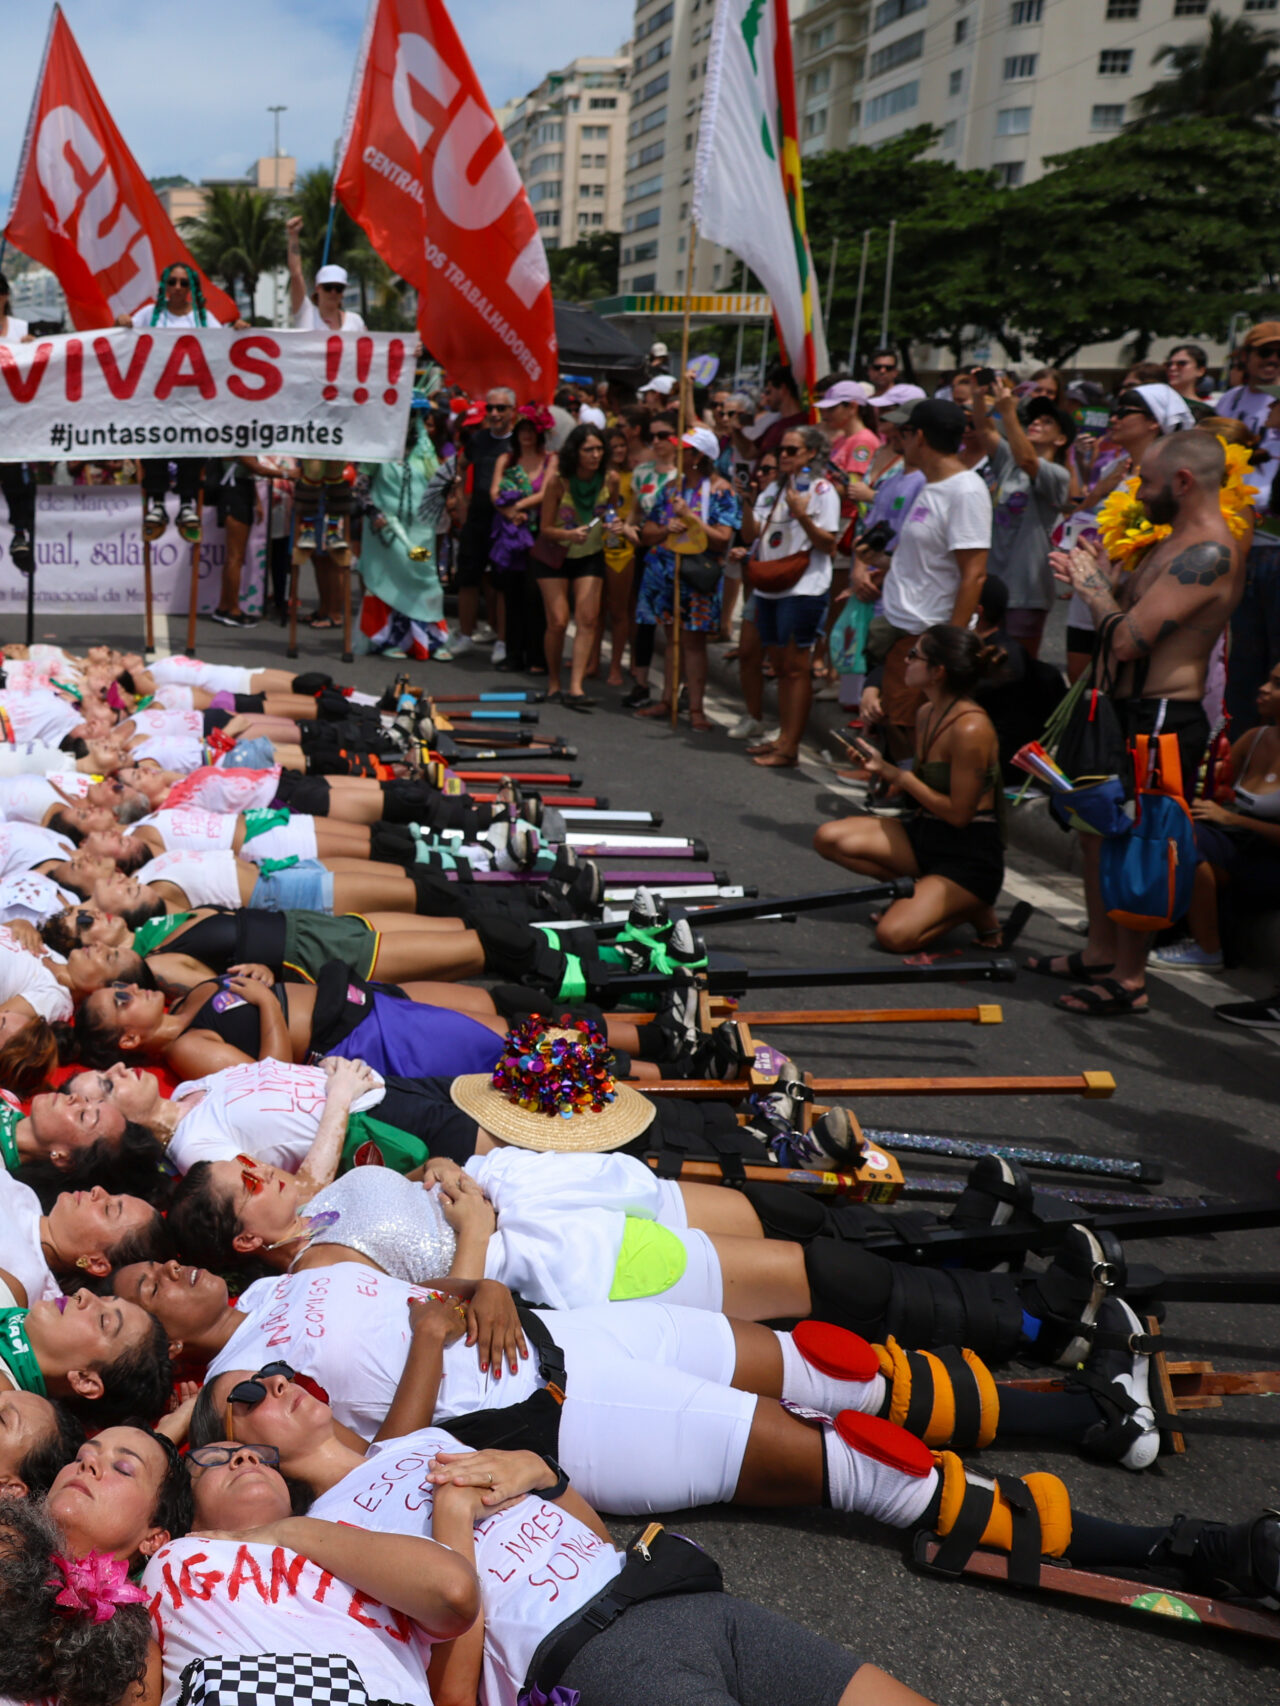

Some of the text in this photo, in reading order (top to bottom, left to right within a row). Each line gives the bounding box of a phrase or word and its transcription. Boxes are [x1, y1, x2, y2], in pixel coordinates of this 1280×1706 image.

[362, 146, 425, 204] CENTRAL
[444, 261, 543, 383] TRABALHADORES
[322, 334, 405, 406] !!!
[50, 420, 344, 452] #juntassomosgigantes
[90, 528, 179, 566] saláio
[260, 1302, 292, 1348] NÃO
[305, 1277, 331, 1338] COMIGO
[488, 1504, 565, 1583] LIVRES
